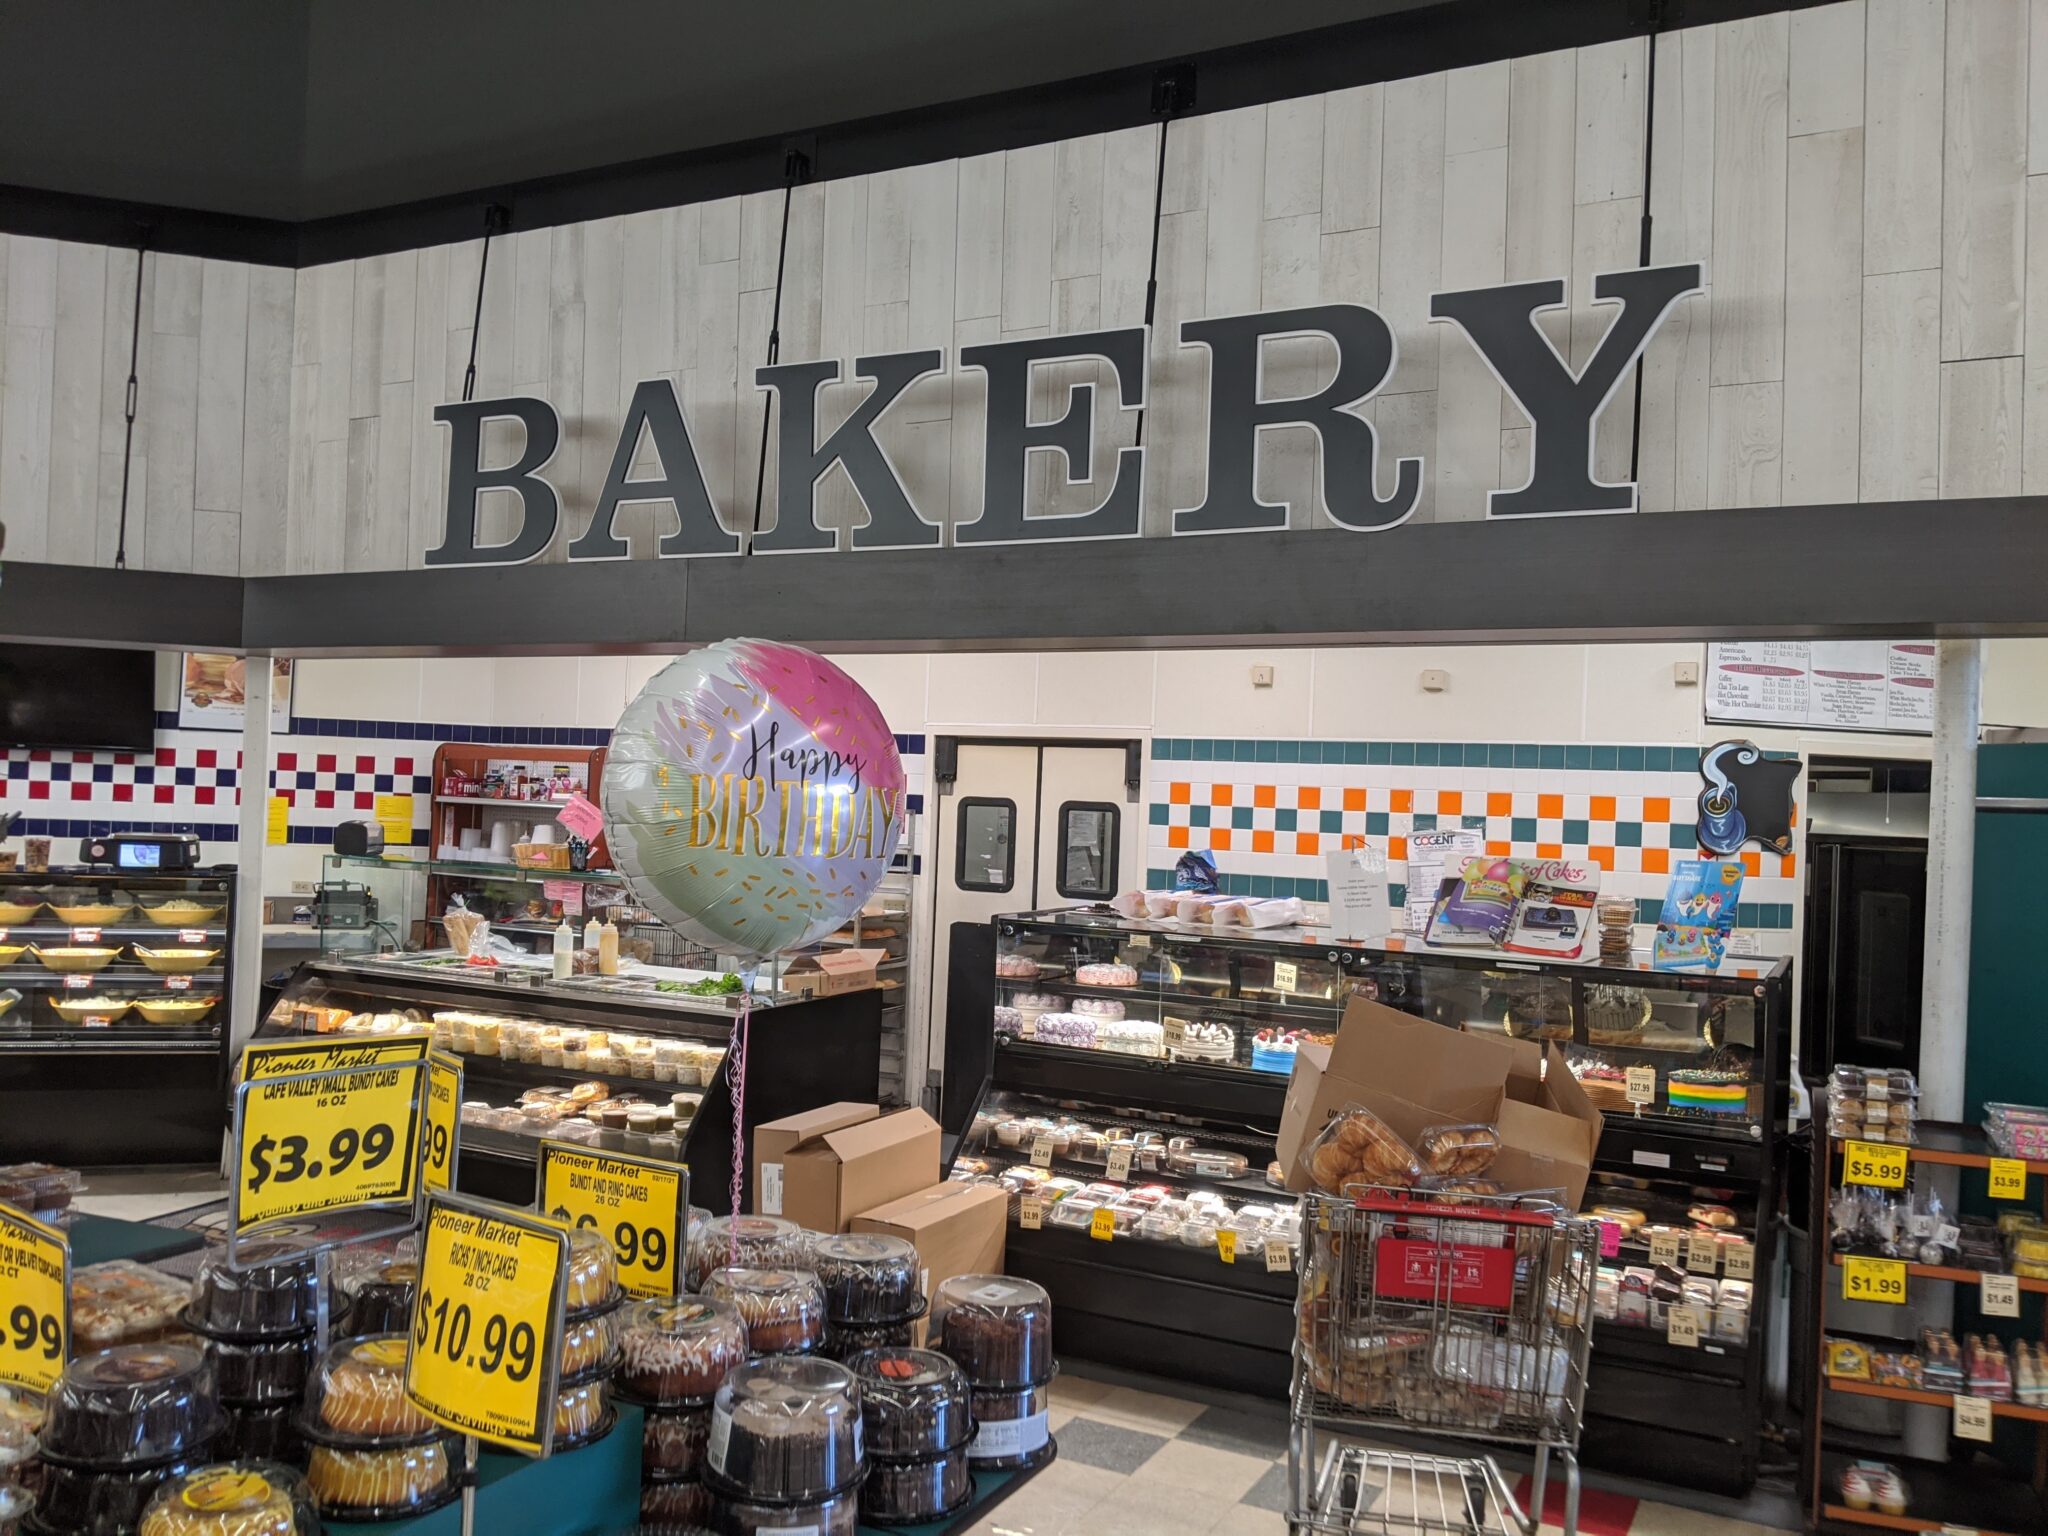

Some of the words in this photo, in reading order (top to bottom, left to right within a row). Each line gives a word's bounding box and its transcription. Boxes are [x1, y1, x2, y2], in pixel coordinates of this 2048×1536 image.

[424, 261, 1707, 570] BAKERY
[742, 721, 867, 794] Happy
[688, 772, 899, 860] BIRTHDAY
[1413, 834, 1456, 846] COGENT
[1529, 861, 1549, 881] of
[1545, 861, 1587, 883] Cakes
[251, 1053, 318, 1079] Pioneer
[322, 1047, 385, 1069] Market
[264, 1081, 286, 1100] CAFE
[288, 1077, 321, 1097] VALLEY
[320, 1073, 347, 1094] SMALL
[348, 1071, 376, 1092] BUNDT
[375, 1069, 400, 1088] CAKES
[1630, 1083, 1650, 1093] $27.99
[316, 1097, 328, 1107] 16
[331, 1095, 347, 1105] OZ
[248, 1123, 395, 1195] $3.99
[548, 1149, 594, 1169] Pioneer
[596, 1159, 640, 1179] Market
[1851, 1160, 1902, 1180] $5.99
[570, 1173, 592, 1190] BUNDT
[593, 1179, 606, 1195] AND
[608, 1181, 623, 1197] RING
[625, 1184, 648, 1203] CAKES
[1994, 1176, 2020, 1188] $3.99
[607, 1197, 620, 1208] OZ
[432, 1208, 475, 1236] Pioneer
[475, 1219, 522, 1248] Market
[4, 1245, 14, 1264] OR
[449, 1242, 470, 1269] RICHS
[468, 1246, 475, 1270] 7
[474, 1249, 493, 1275] INCH
[492, 1254, 518, 1281] CAKES
[1433, 1249, 1464, 1259] WARNNG
[7, 1266, 19, 1279] CT
[464, 1272, 475, 1287] 28
[476, 1276, 491, 1291] OZ
[1850, 1275, 1902, 1295] $1.99
[416, 1288, 536, 1383] $10.99
